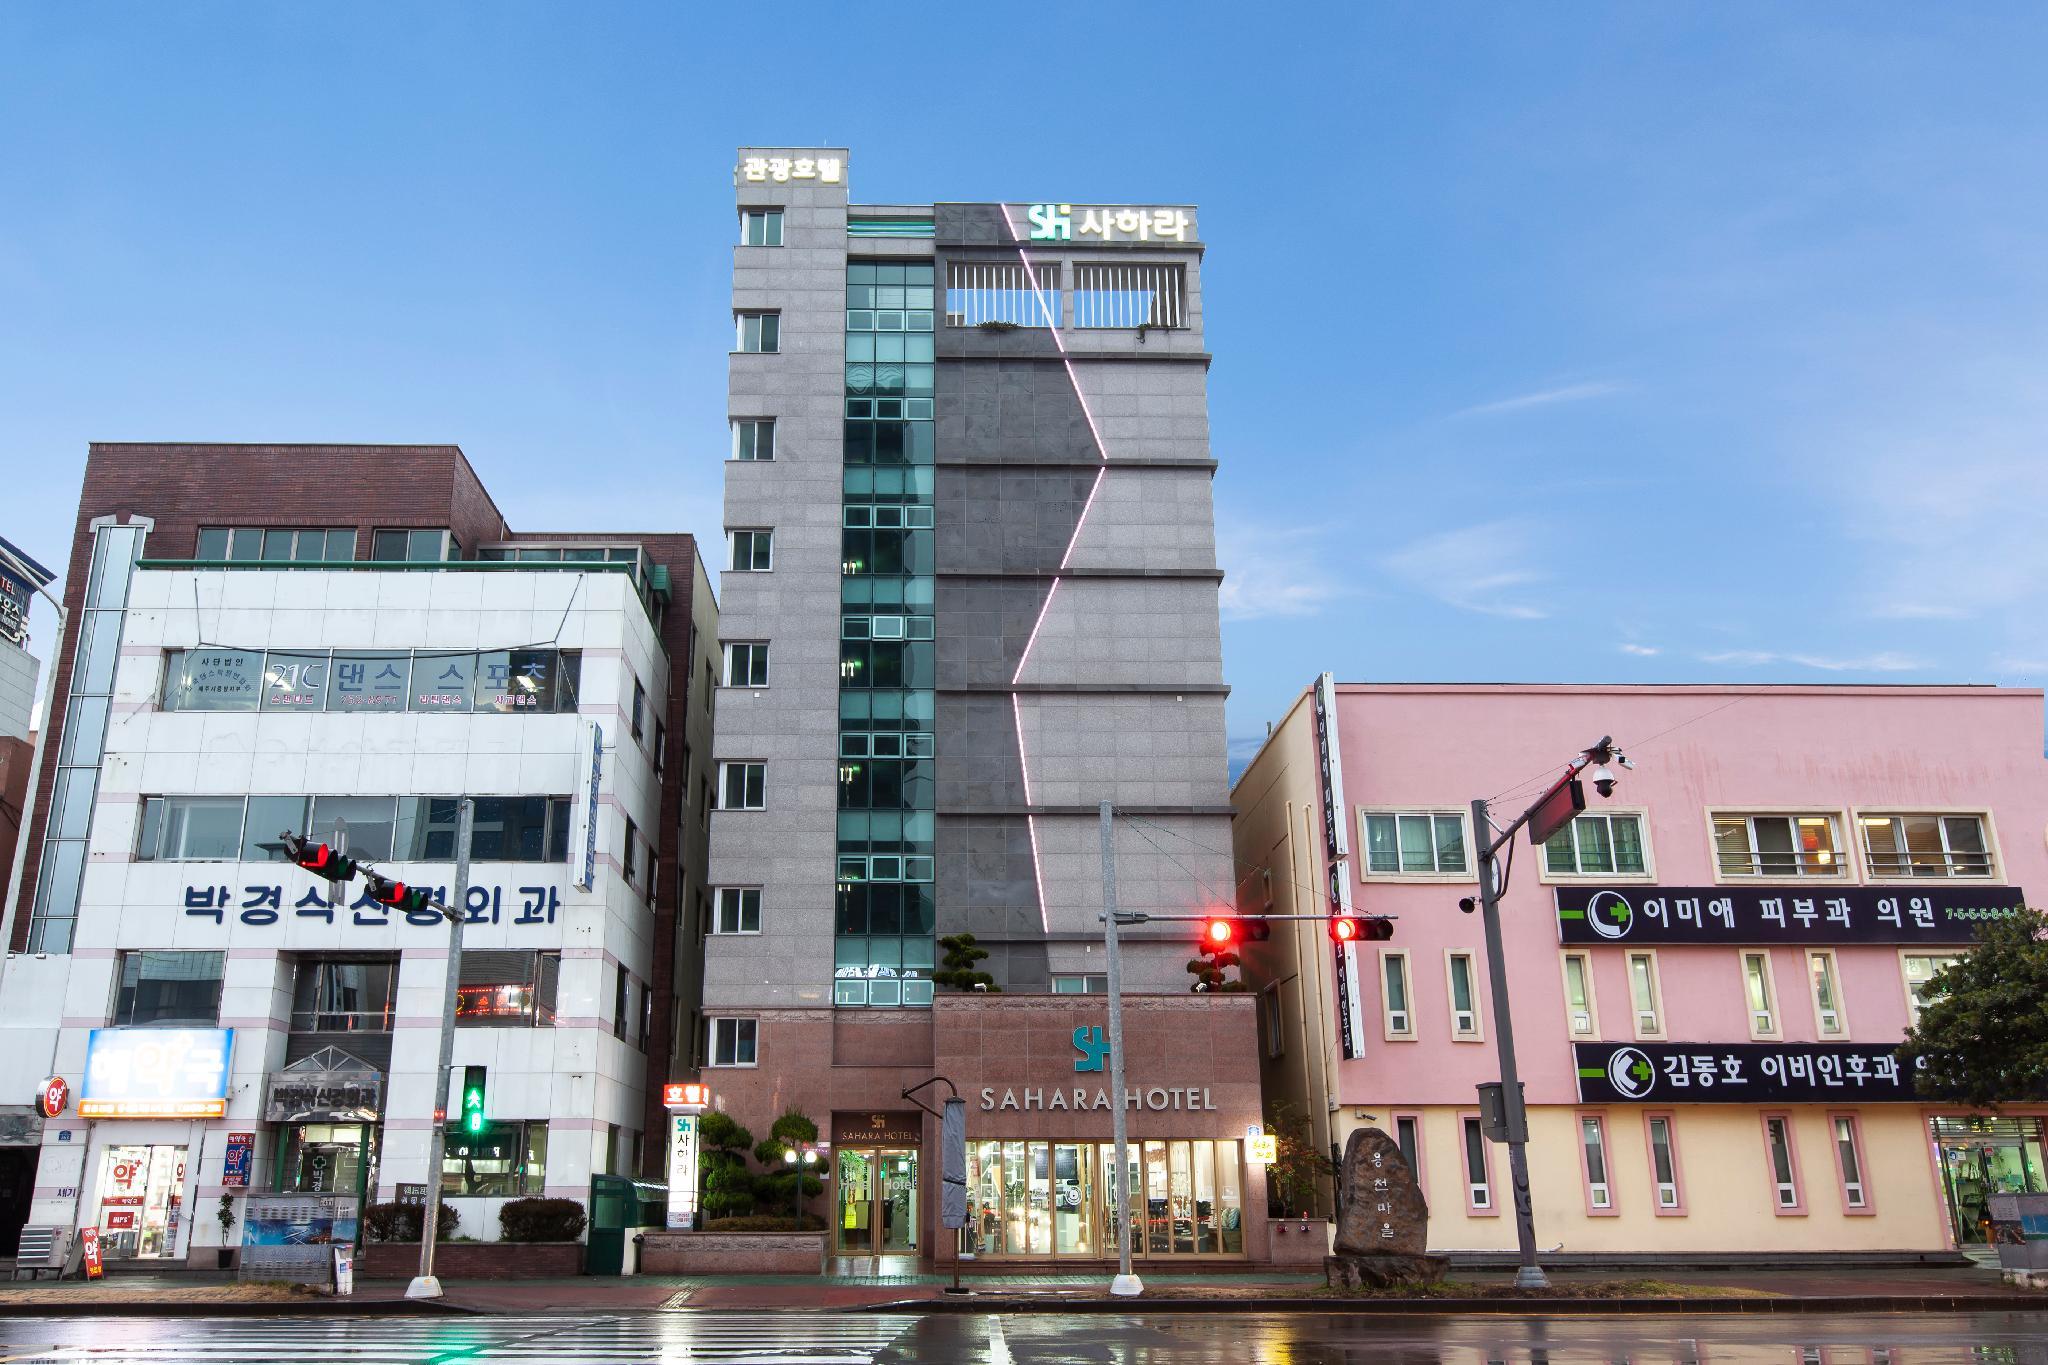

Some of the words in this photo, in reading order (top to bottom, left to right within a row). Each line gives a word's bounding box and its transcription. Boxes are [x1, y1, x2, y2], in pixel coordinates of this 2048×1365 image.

[743, 156, 841, 184] 관광호텔
[1078, 207, 1189, 242] 사하라
[0, 595, 20, 622] 우스
[201, 658, 244, 667] 사단법인
[270, 664, 323, 689] 21C
[338, 663, 401, 692] 댄스
[437, 662, 546, 690] 스포츠
[1643, 897, 1736, 929] 이미애
[1759, 897, 1852, 929] 피부과
[1876, 897, 1936, 929] 의원
[1663, 1055, 1748, 1088] 김동호
[1760, 1054, 1900, 1088] 이비인후과
[49, 1086, 65, 1112] 약
[667, 1083, 700, 1102] 호텔
[980, 1087, 1112, 1111] SAHARA
[1124, 1087, 1218, 1111] HOTEL
[842, 1131, 881, 1141] SAHARA
[884, 1131, 913, 1140] HOTEL
[113, 1160, 139, 1190] 약
[85, 1237, 99, 1264] 약
